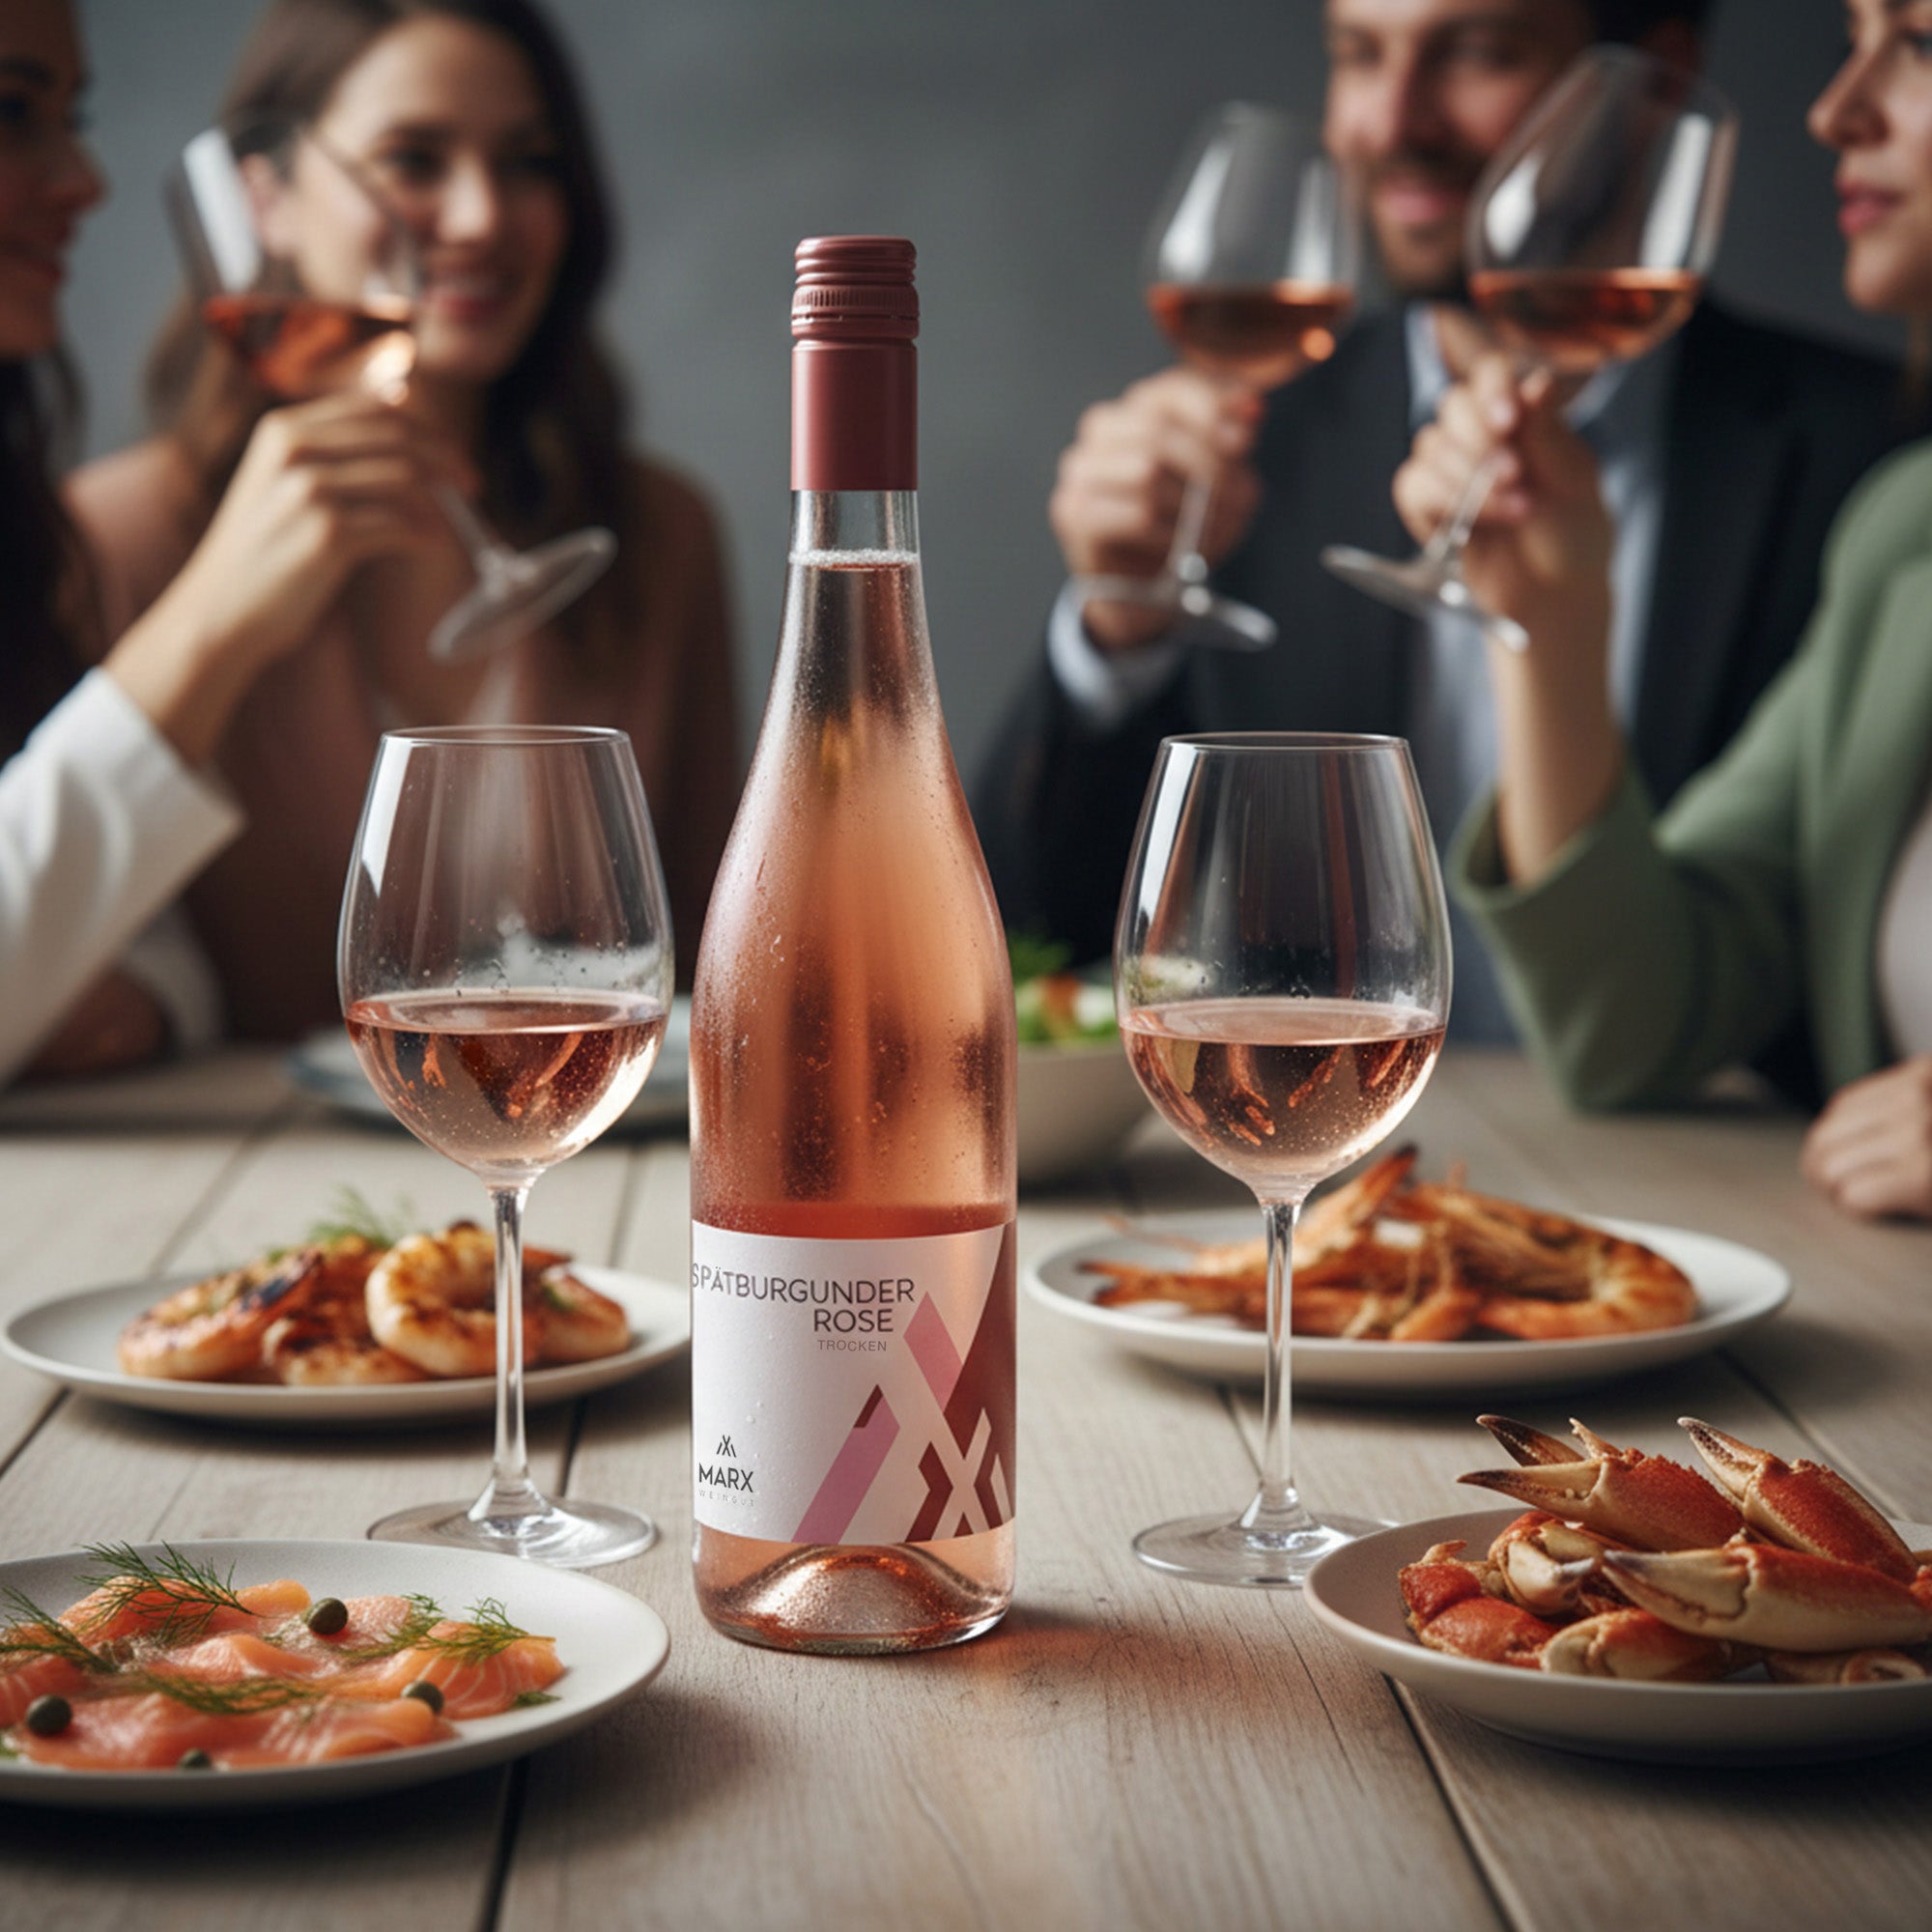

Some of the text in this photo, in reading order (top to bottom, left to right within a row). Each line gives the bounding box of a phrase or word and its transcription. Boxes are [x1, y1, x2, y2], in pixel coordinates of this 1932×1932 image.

[692, 1263, 915, 1304] SPÄTBURGUNDER
[813, 1308, 894, 1332] ROSE
[817, 1339, 887, 1351] TROCKEN
[698, 1462, 753, 1493] MARX
[698, 1490, 753, 1507] WEINGUT
